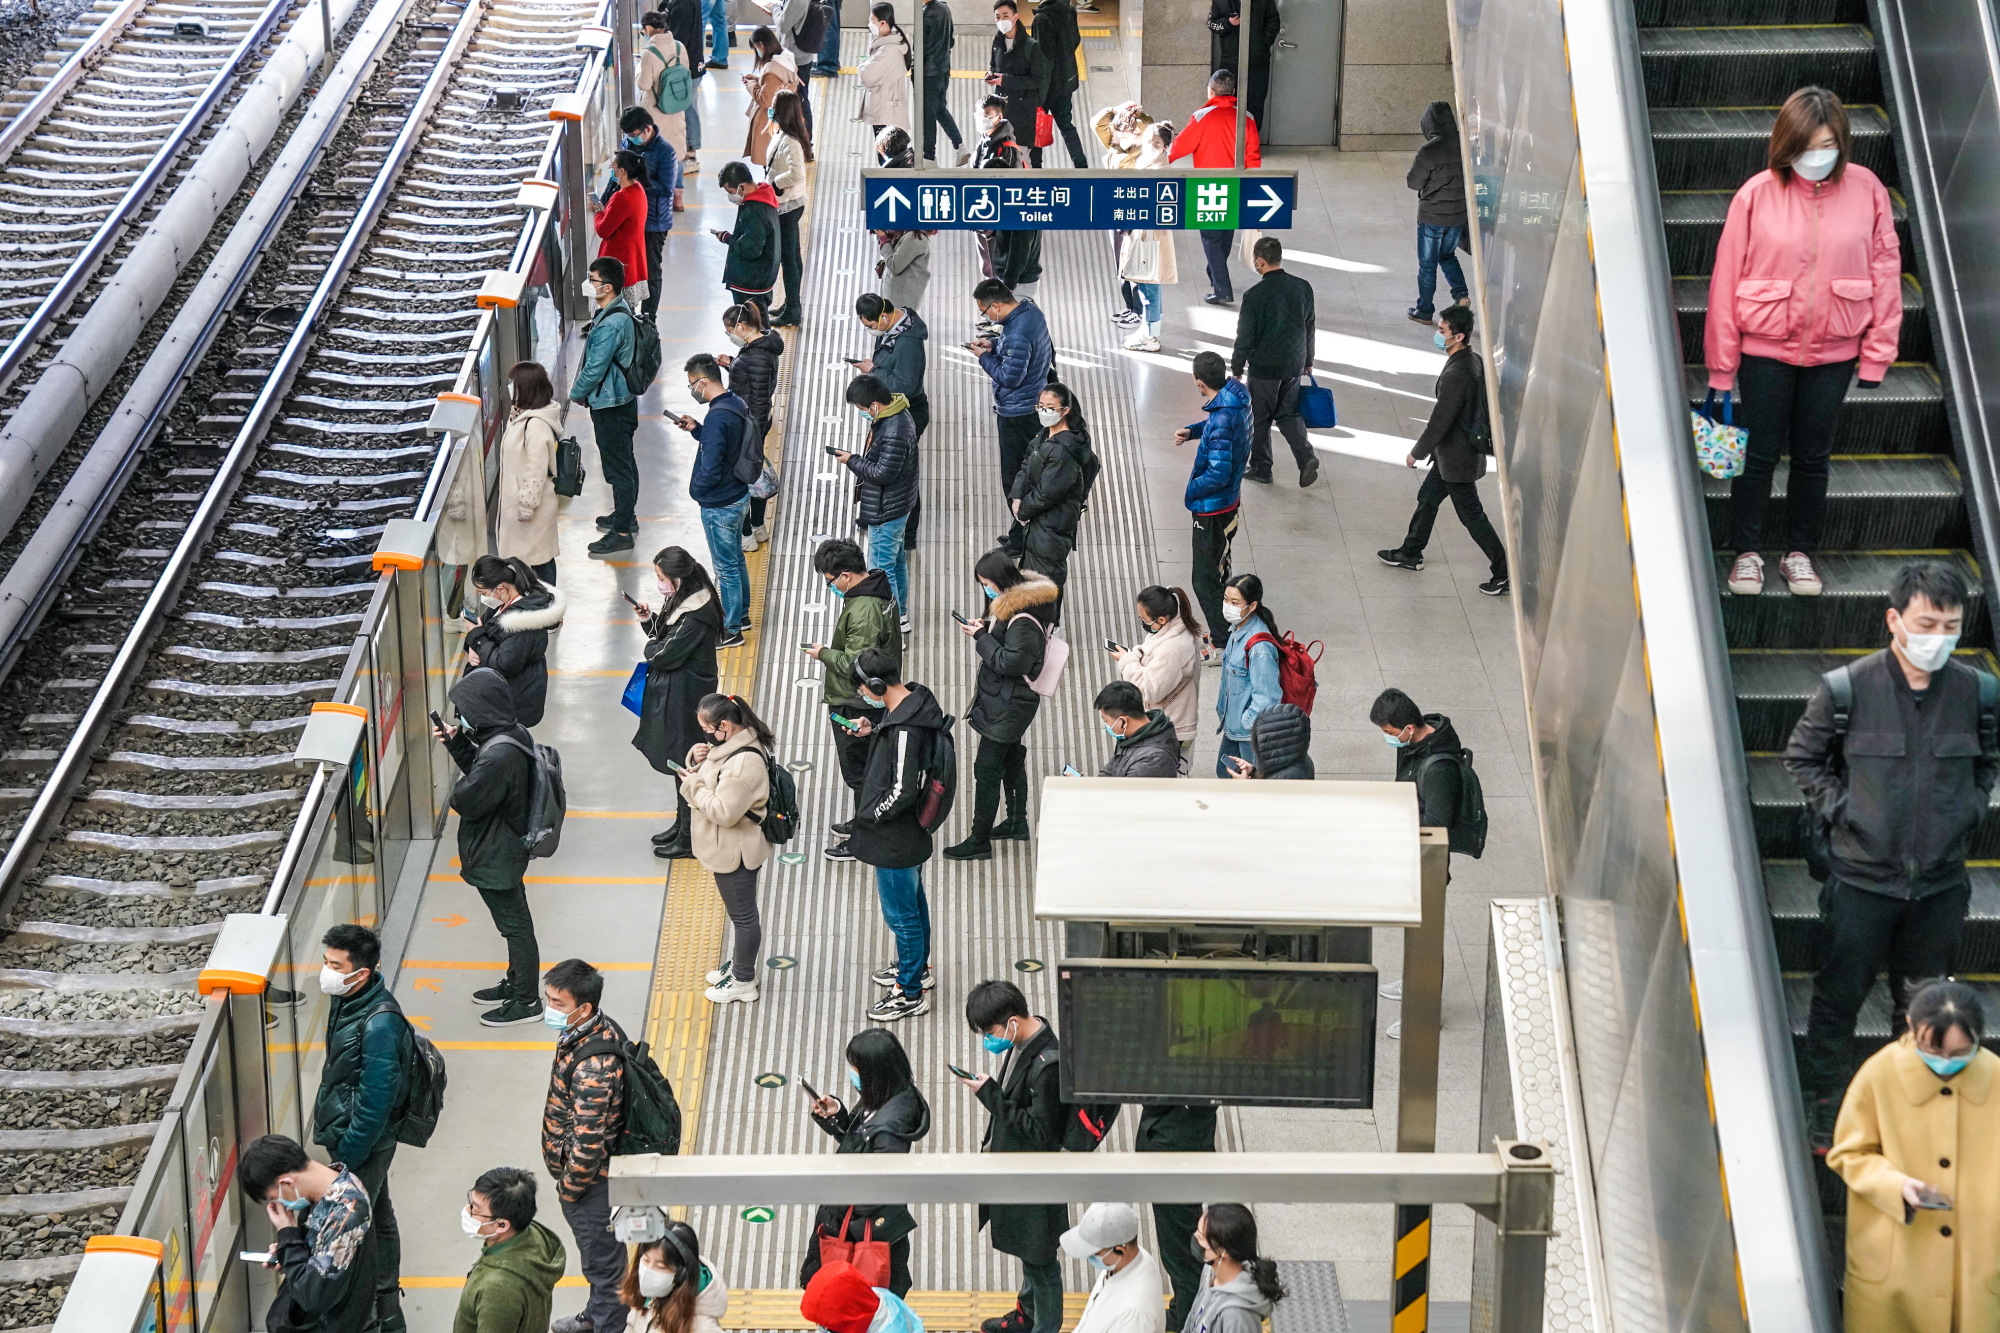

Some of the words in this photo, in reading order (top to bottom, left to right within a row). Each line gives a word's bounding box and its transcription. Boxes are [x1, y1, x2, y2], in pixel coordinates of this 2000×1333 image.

[1003, 186, 1070, 207] 卫生间
[1113, 186, 1149, 199] 北出口
[1160, 184, 1174, 200] A
[1197, 183, 1228, 211] 出
[1019, 211, 1053, 222] Toilet
[1113, 208, 1149, 221] 南出口
[1161, 207, 1174, 223] B
[1197, 212, 1228, 222] EXIT
